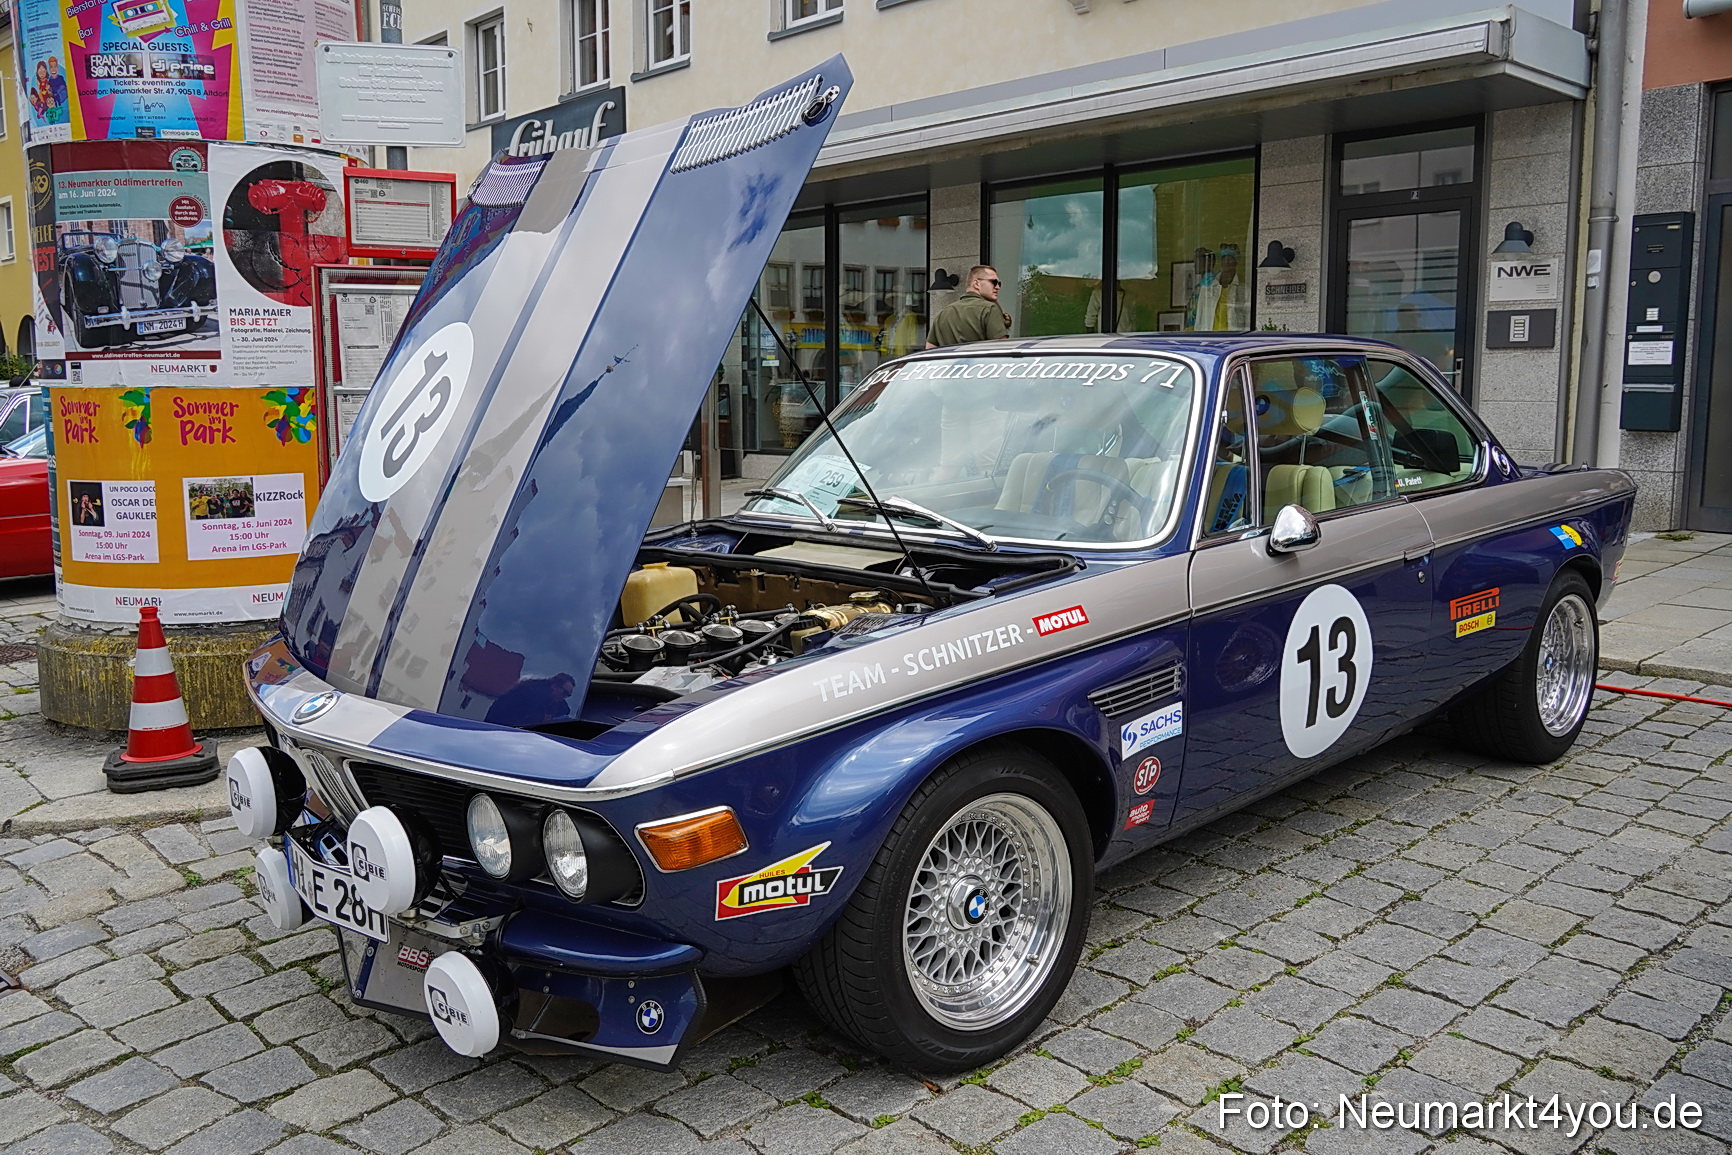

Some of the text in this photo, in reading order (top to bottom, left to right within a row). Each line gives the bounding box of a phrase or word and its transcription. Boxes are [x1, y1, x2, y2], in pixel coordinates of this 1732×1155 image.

[79, 27, 94, 39] Bar
[174, 18, 232, 38] Chill & Grill
[102, 42, 192, 53] SPECIAL GUESTS:
[90, 54, 125, 66] FRANK
[91, 65, 137, 78] SONIQUE
[152, 60, 214, 76] dj prime
[79, 88, 109, 96] Location:
[178, 88, 201, 96] 90518
[58, 178, 183, 189] 13. Neumarkter Oldtimertreffen
[69, 190, 78, 198] 16.
[80, 189, 96, 198] Juni
[97, 189, 116, 197] 2024
[1498, 264, 1551, 278] NWE
[1266, 284, 1306, 295] SCHNEIDER
[229, 308, 291, 316] MARIA MAIER
[230, 318, 278, 326] BIS JETZT
[150, 364, 207, 373] NEUMARKT
[1139, 362, 1186, 388] 71
[60, 396, 100, 417] Sommer
[172, 396, 239, 418] Sommer
[79, 414, 89, 425] im
[208, 414, 222, 426] im
[380, 349, 452, 478] 13
[64, 420, 99, 444] Park
[180, 418, 236, 446] Park
[819, 469, 845, 488] 259
[111, 498, 140, 506] OSCAR
[256, 490, 304, 502] KIZZRock
[116, 512, 157, 520] GAUKLER
[202, 518, 292, 532] Sonntag, 16. Juni 2024
[78, 529, 102, 539] Sonntag,
[229, 531, 270, 541] 15:00 Uhr
[211, 541, 287, 553] Arena im LGS-Park
[113, 553, 145, 561] LGS-Park
[1450, 587, 1500, 621] PIRELLI
[1038, 608, 1086, 634] MOTUL
[1458, 619, 1480, 634] BOSCH
[812, 662, 886, 702] TEAM
[904, 623, 1024, 676] SCHNITZER
[1296, 616, 1356, 729] 13
[1140, 710, 1182, 736] SACHS
[1140, 726, 1182, 750] PERFORMANCE
[1136, 760, 1157, 788] STP
[1129, 804, 1148, 817] auto
[759, 869, 786, 879] HUILES
[312, 868, 328, 914] E
[743, 873, 825, 903] motul
[399, 945, 429, 966] BBS
[641, 1002, 662, 1014] BMW
